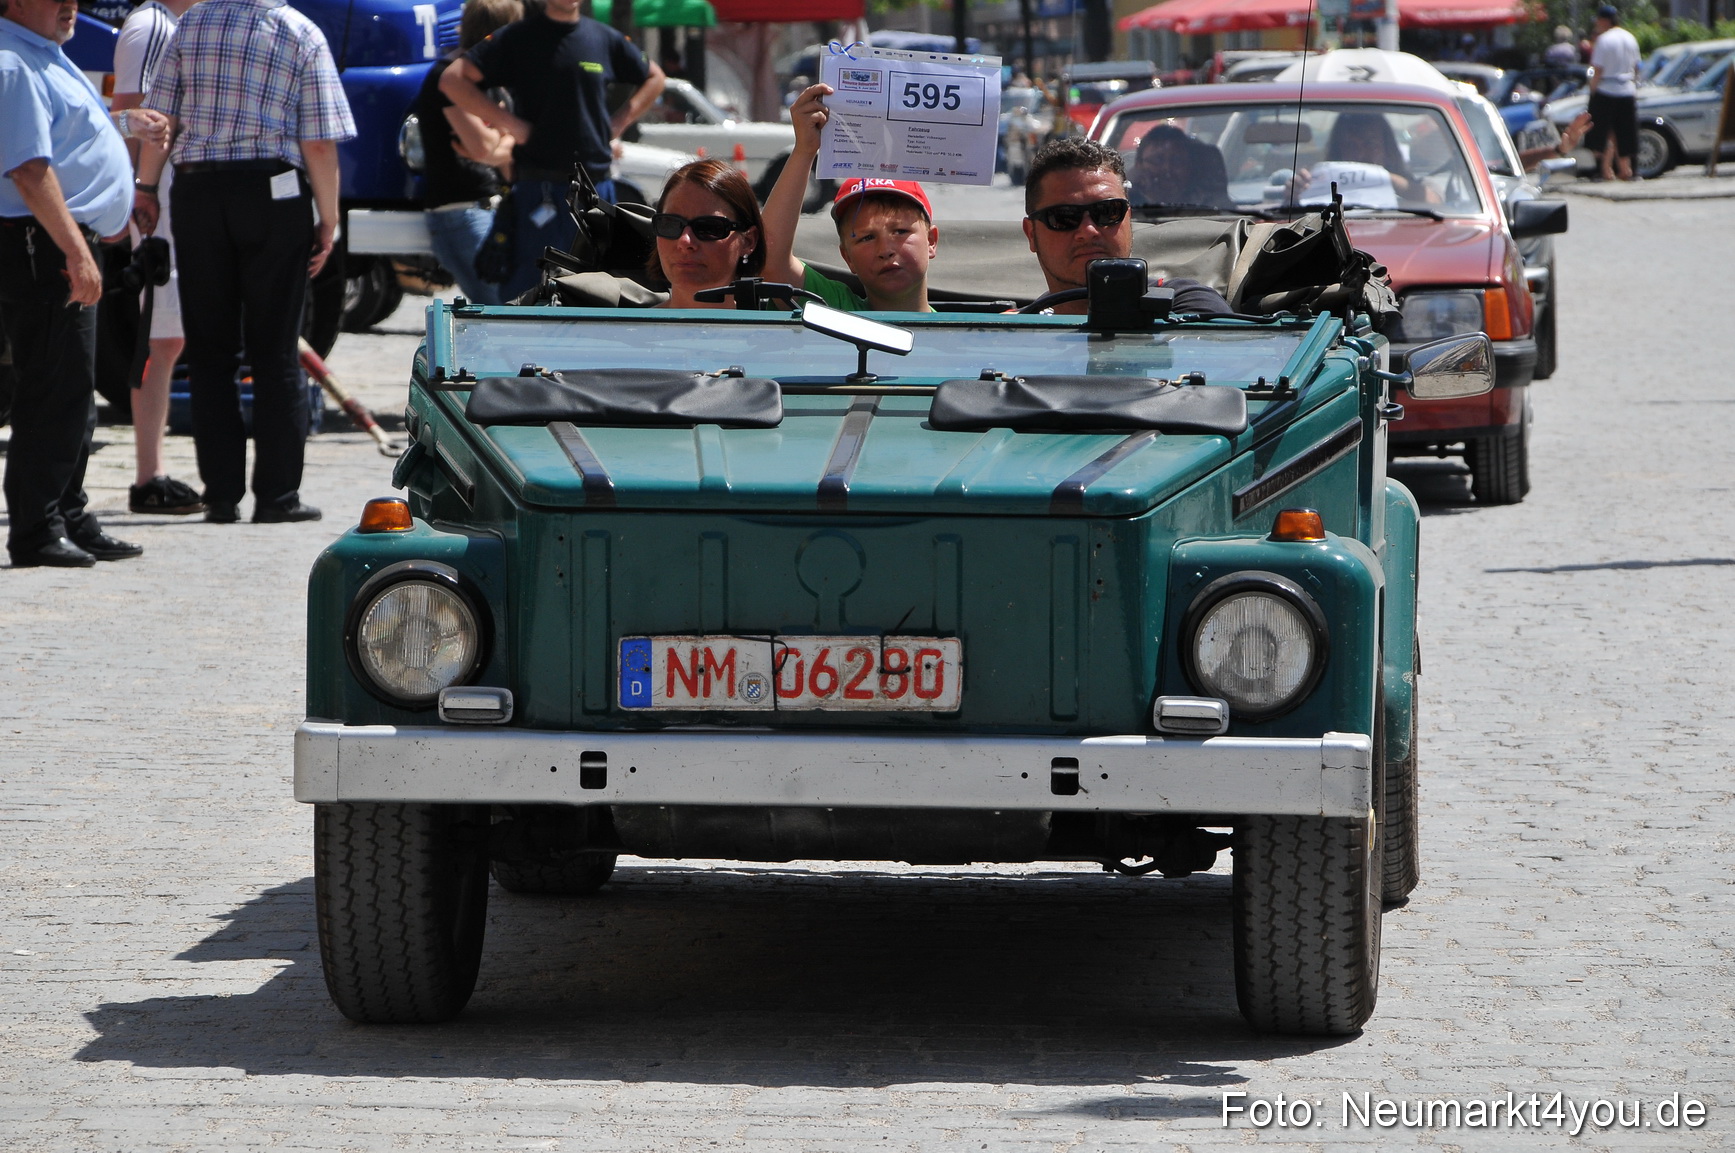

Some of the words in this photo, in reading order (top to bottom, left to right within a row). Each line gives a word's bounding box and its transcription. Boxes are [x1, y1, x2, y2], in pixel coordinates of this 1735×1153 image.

[412, 3, 438, 59] T
[902, 82, 961, 111] 595
[1339, 170, 1366, 186] 577
[631, 680, 643, 696] D
[666, 647, 737, 699] NM
[775, 647, 945, 700] 06280
